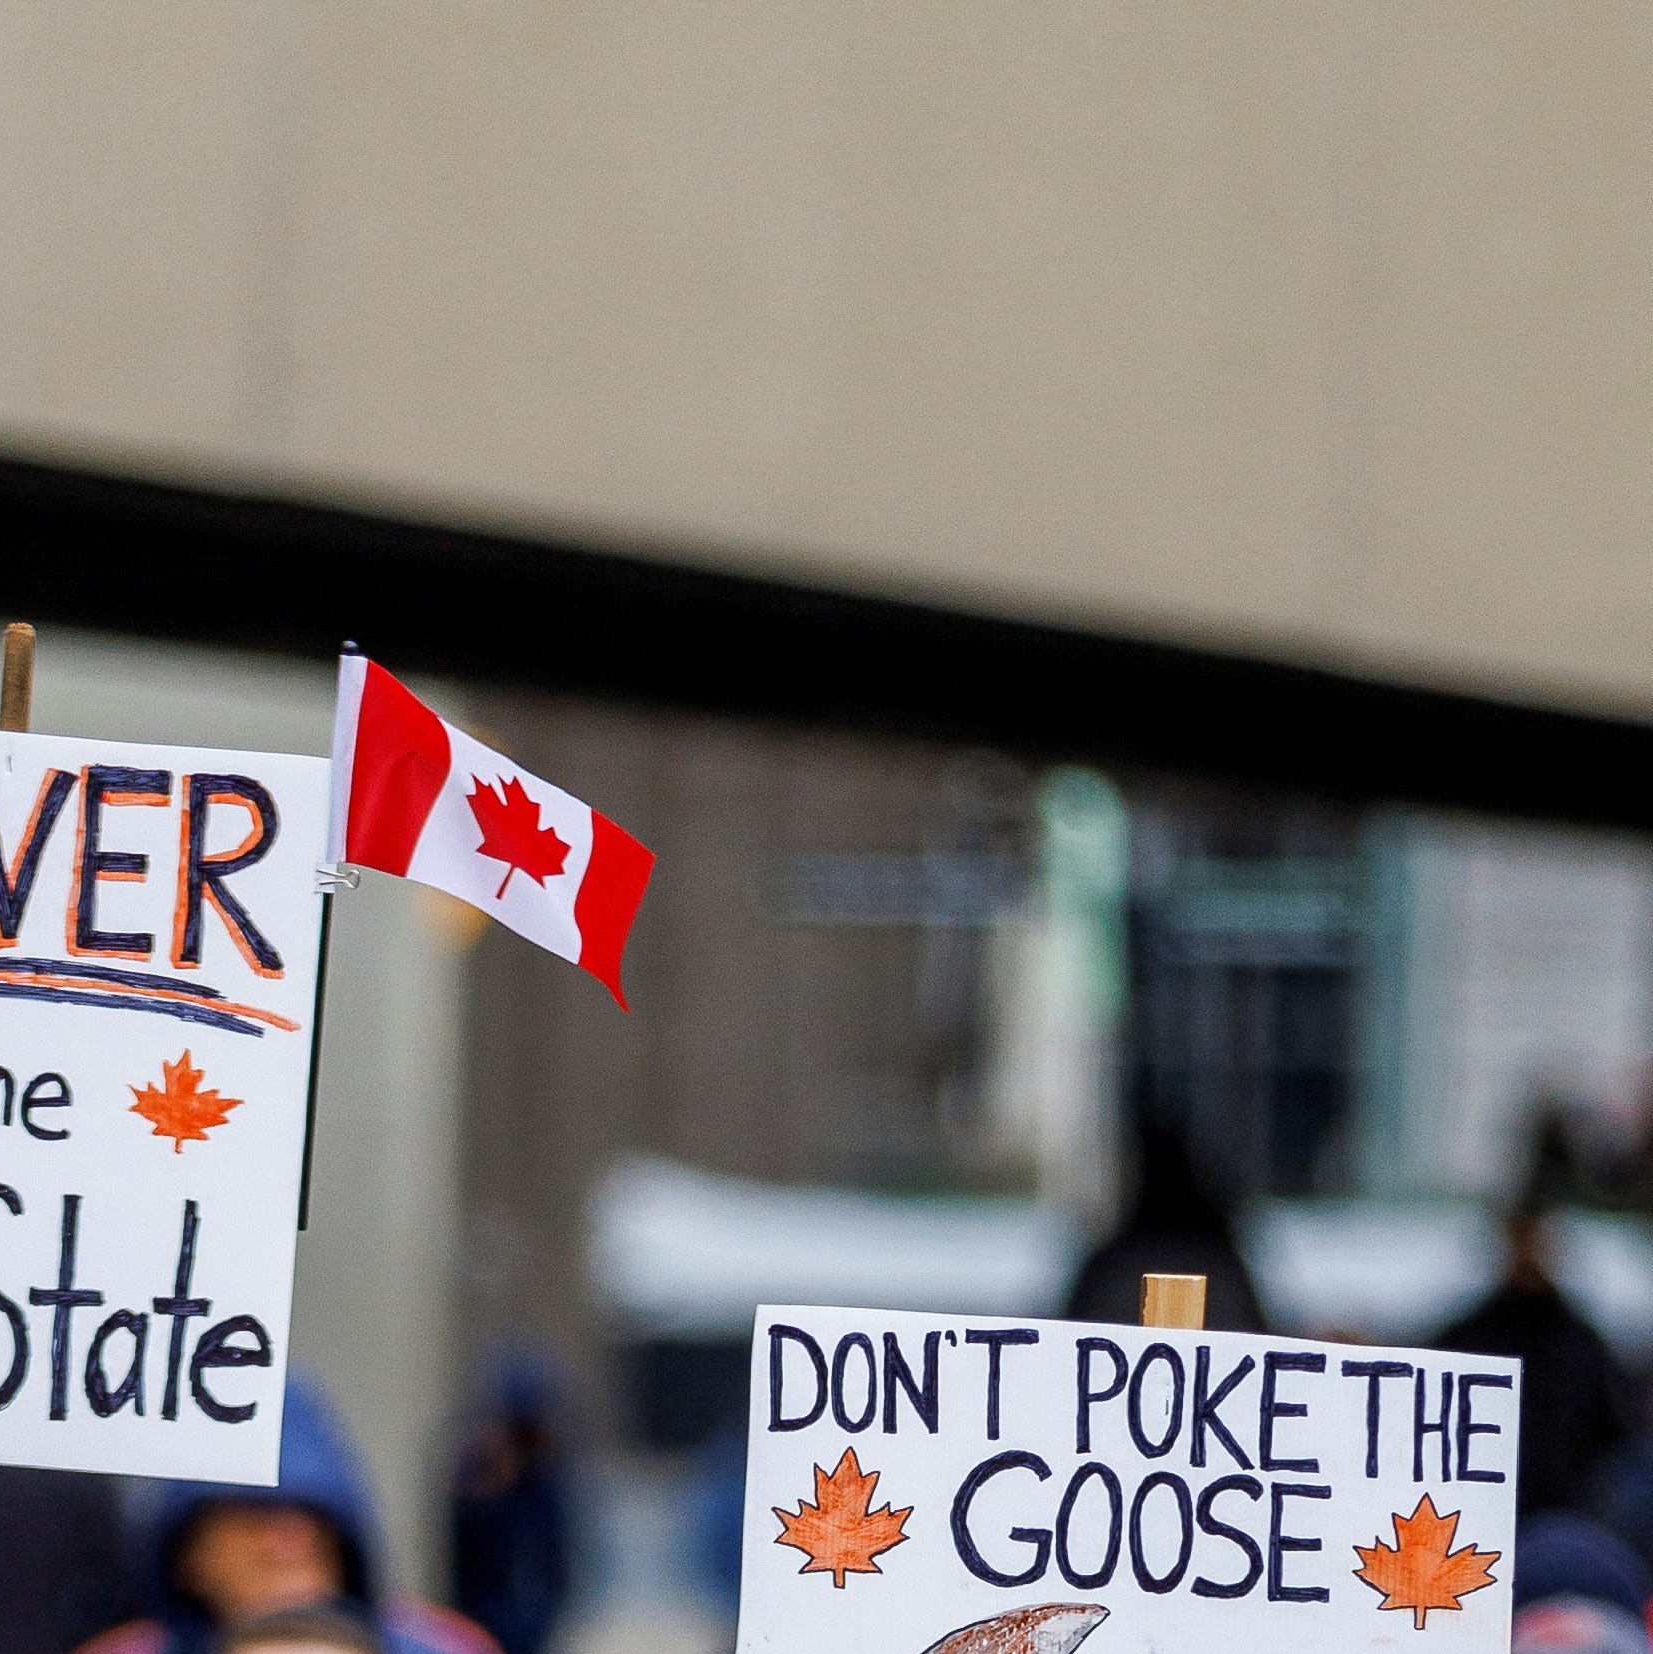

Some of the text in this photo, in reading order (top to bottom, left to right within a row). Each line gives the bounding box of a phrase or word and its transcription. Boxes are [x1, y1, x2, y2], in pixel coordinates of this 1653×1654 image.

[768, 1325, 1512, 1484] DON'T POKE THE
[951, 1450, 1331, 1602] GOOSE
